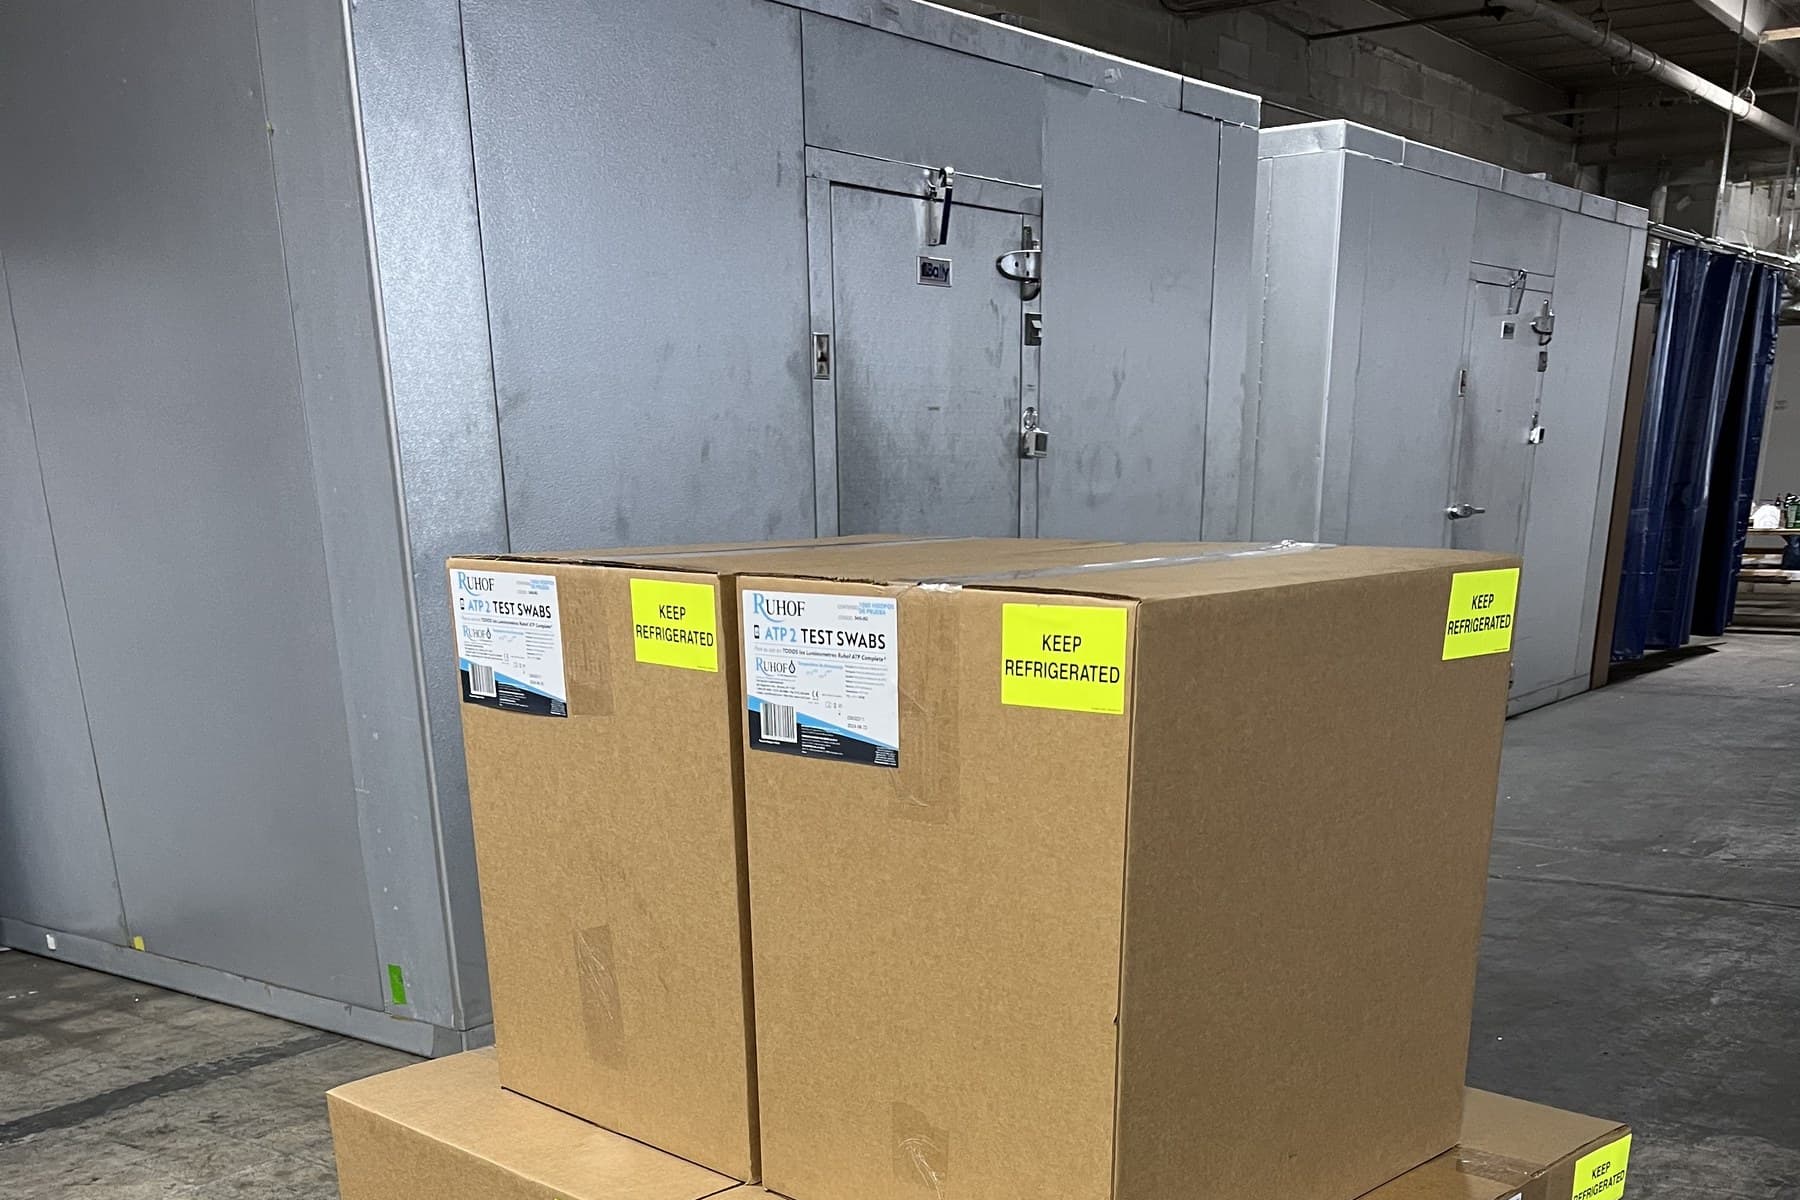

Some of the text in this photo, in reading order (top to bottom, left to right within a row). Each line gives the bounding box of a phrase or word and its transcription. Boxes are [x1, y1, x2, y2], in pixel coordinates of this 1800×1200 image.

[457, 571, 495, 596] RUHOF
[468, 599, 552, 618] ATP 2 TEST SWABS
[658, 604, 686, 620] KEEP
[752, 593, 805, 623] RUHOF
[1471, 593, 1494, 610] KEEP
[1447, 614, 1511, 635] REFRIGERATED
[635, 624, 714, 647] REFRIGERATED
[765, 625, 886, 649] ATP 2 TEST SWABS
[1042, 634, 1082, 652] KEEP
[1005, 659, 1120, 683] REFRIGERATED
[1591, 1161, 1611, 1179] KEEP
